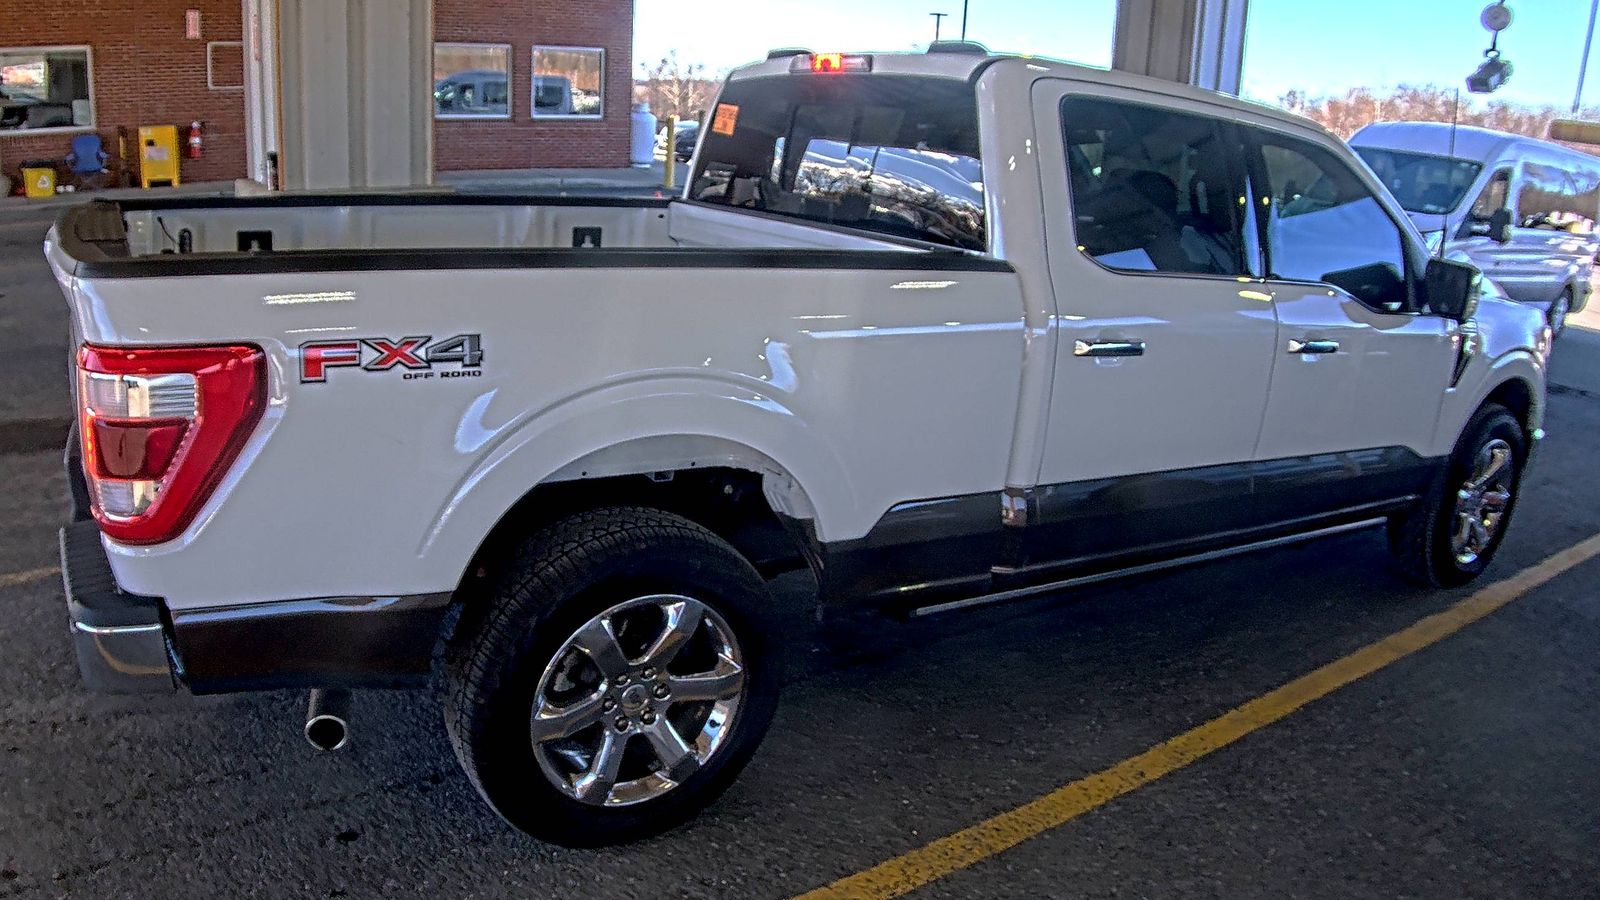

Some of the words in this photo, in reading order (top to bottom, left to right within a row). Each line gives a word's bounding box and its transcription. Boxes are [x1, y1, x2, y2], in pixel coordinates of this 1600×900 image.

[299, 334, 483, 384] FX4
[402, 371, 434, 380] OFF
[440, 369, 482, 379] ROAD
